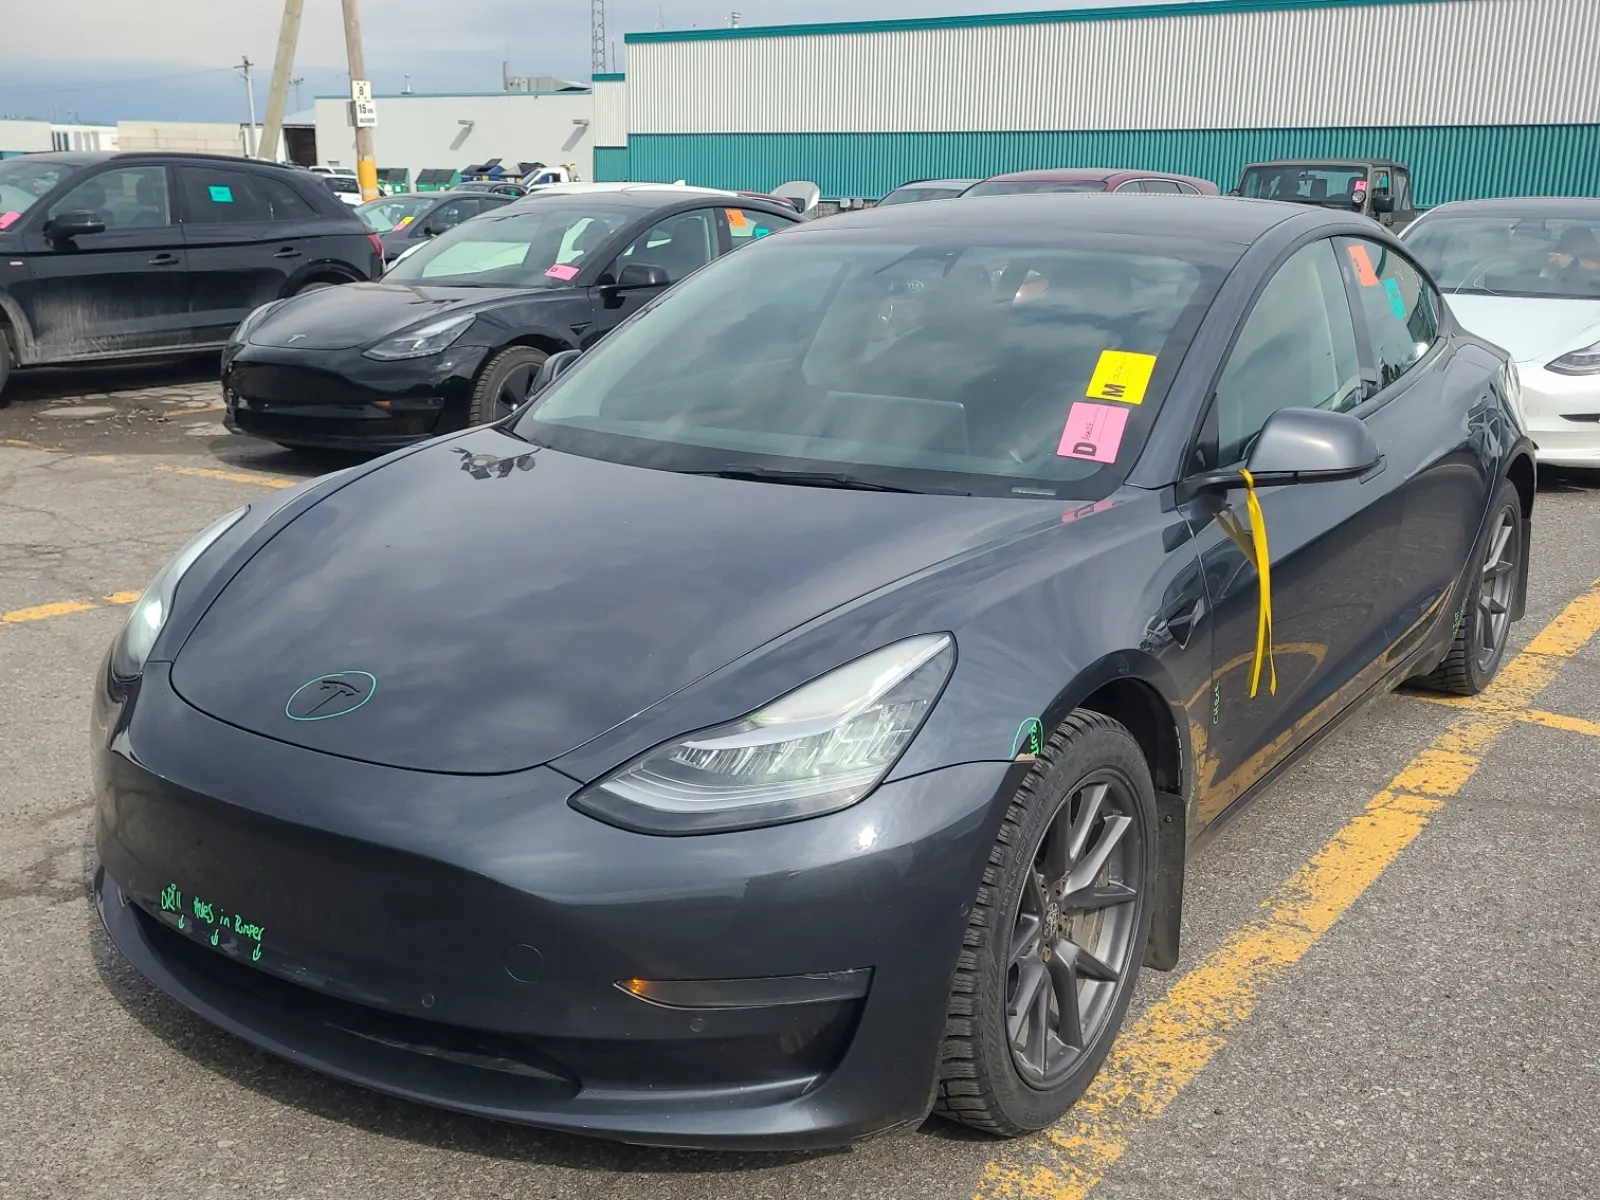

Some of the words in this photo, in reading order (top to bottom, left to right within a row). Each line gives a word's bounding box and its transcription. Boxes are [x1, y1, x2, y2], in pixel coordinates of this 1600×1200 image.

[359, 104, 366, 114] 15
[1101, 383, 1126, 398] M
[1072, 441, 1097, 457] D
[219, 908, 231, 928] in
